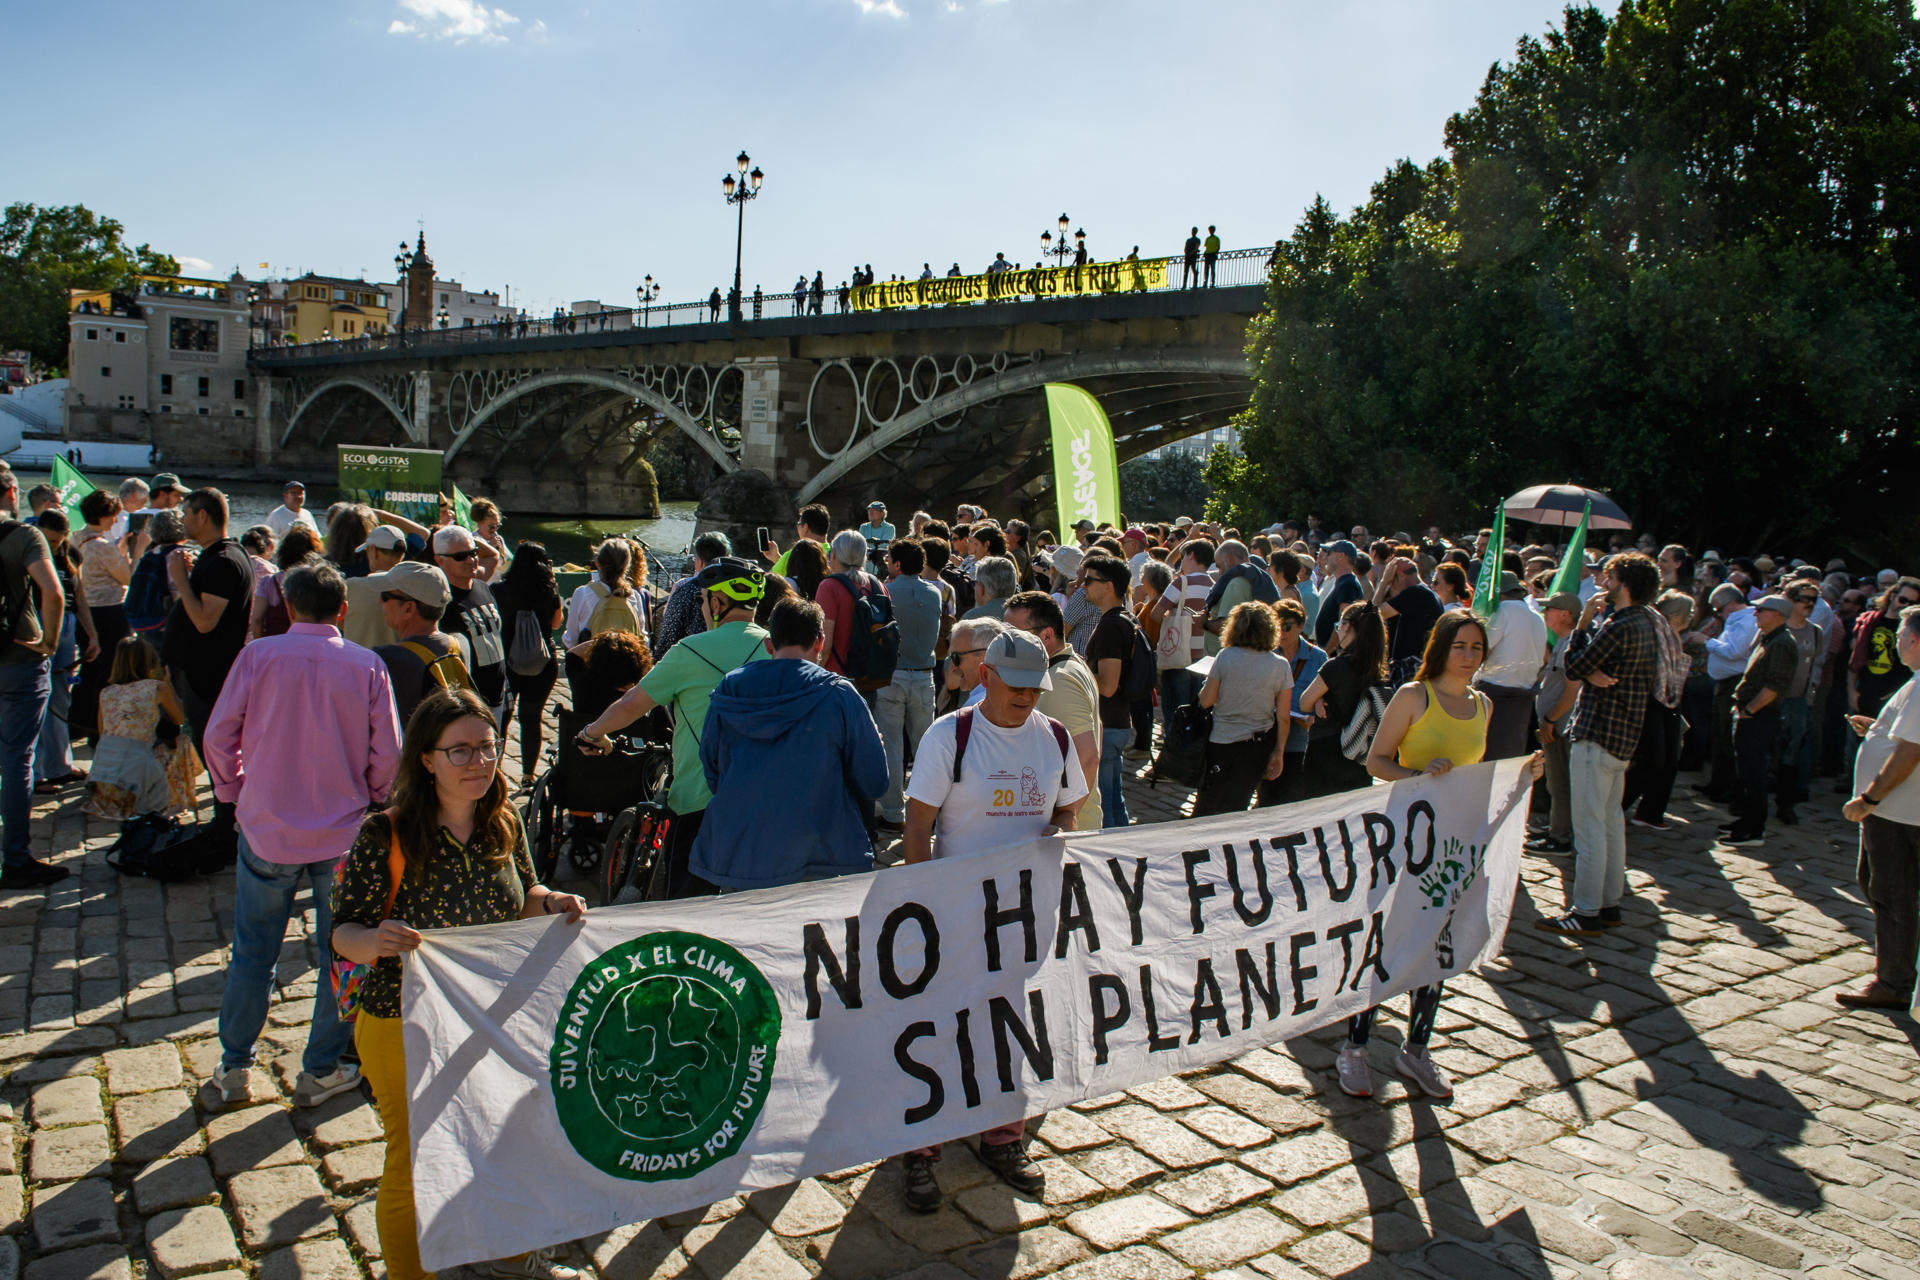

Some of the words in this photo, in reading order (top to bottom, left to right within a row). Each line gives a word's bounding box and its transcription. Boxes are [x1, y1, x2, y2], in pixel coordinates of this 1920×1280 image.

[858, 286, 875, 308] NO
[879, 283, 888, 306] A
[889, 281, 914, 305] LOS
[917, 275, 983, 303] VERTIDOS
[987, 269, 1058, 297] MINEROS
[1063, 266, 1083, 293] AL
[343, 453, 409, 465] ECOLOGISTAS
[385, 491, 439, 503] conservar
[993, 789, 1014, 807] 20
[803, 902, 941, 1020] NO
[982, 857, 1148, 972] HAY
[1182, 800, 1436, 935] FUTURO
[559, 966, 620, 1090] JUVENTUD
[625, 951, 648, 974] X
[653, 945, 677, 966] EL
[683, 946, 747, 996] CLIMA
[894, 989, 1055, 1125] SIN
[1089, 911, 1391, 1066] PLANETA
[618, 1148, 702, 1173] FRIDAYS
[703, 1119, 740, 1158] FOR
[731, 1044, 768, 1121] FUTURE
